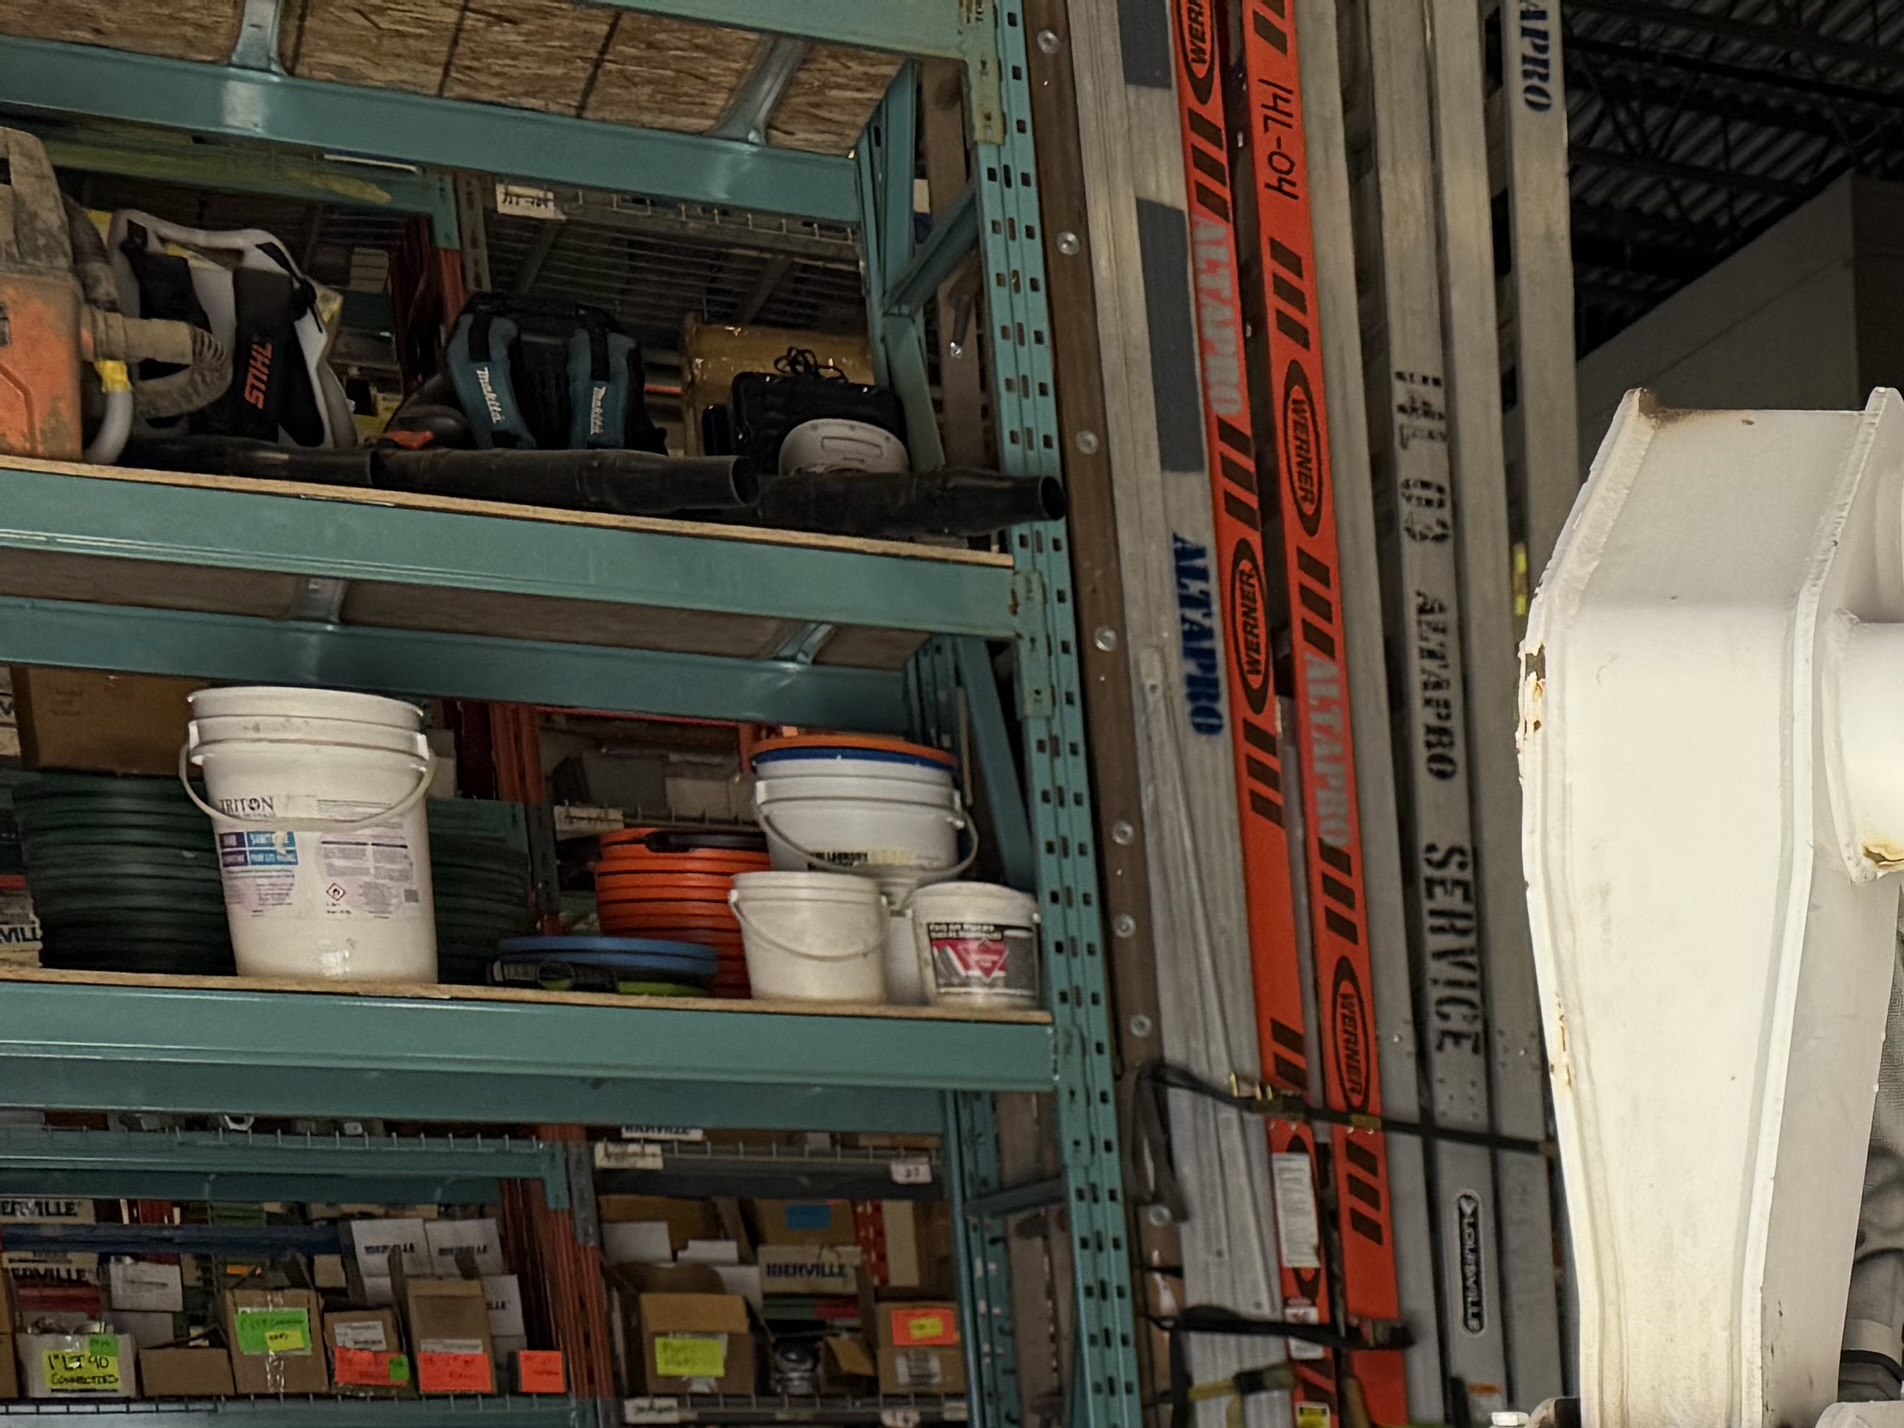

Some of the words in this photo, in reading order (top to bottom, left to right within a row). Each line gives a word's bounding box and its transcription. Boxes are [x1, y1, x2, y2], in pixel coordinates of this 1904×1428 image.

[1259, 78, 1299, 199] 14L-04
[243, 341, 273, 411] STIHL
[1191, 216, 1242, 418] ALTAPRO
[1292, 398, 1314, 504] WERNER
[1172, 532, 1225, 736] ALTAPRO
[1241, 570, 1260, 678] WERNER
[1416, 589, 1458, 780] ALTAPRO
[1304, 650, 1351, 847] ALTAPRO
[1422, 842, 1481, 1055] SERVICE
[1340, 990, 1364, 1094] WERNER
